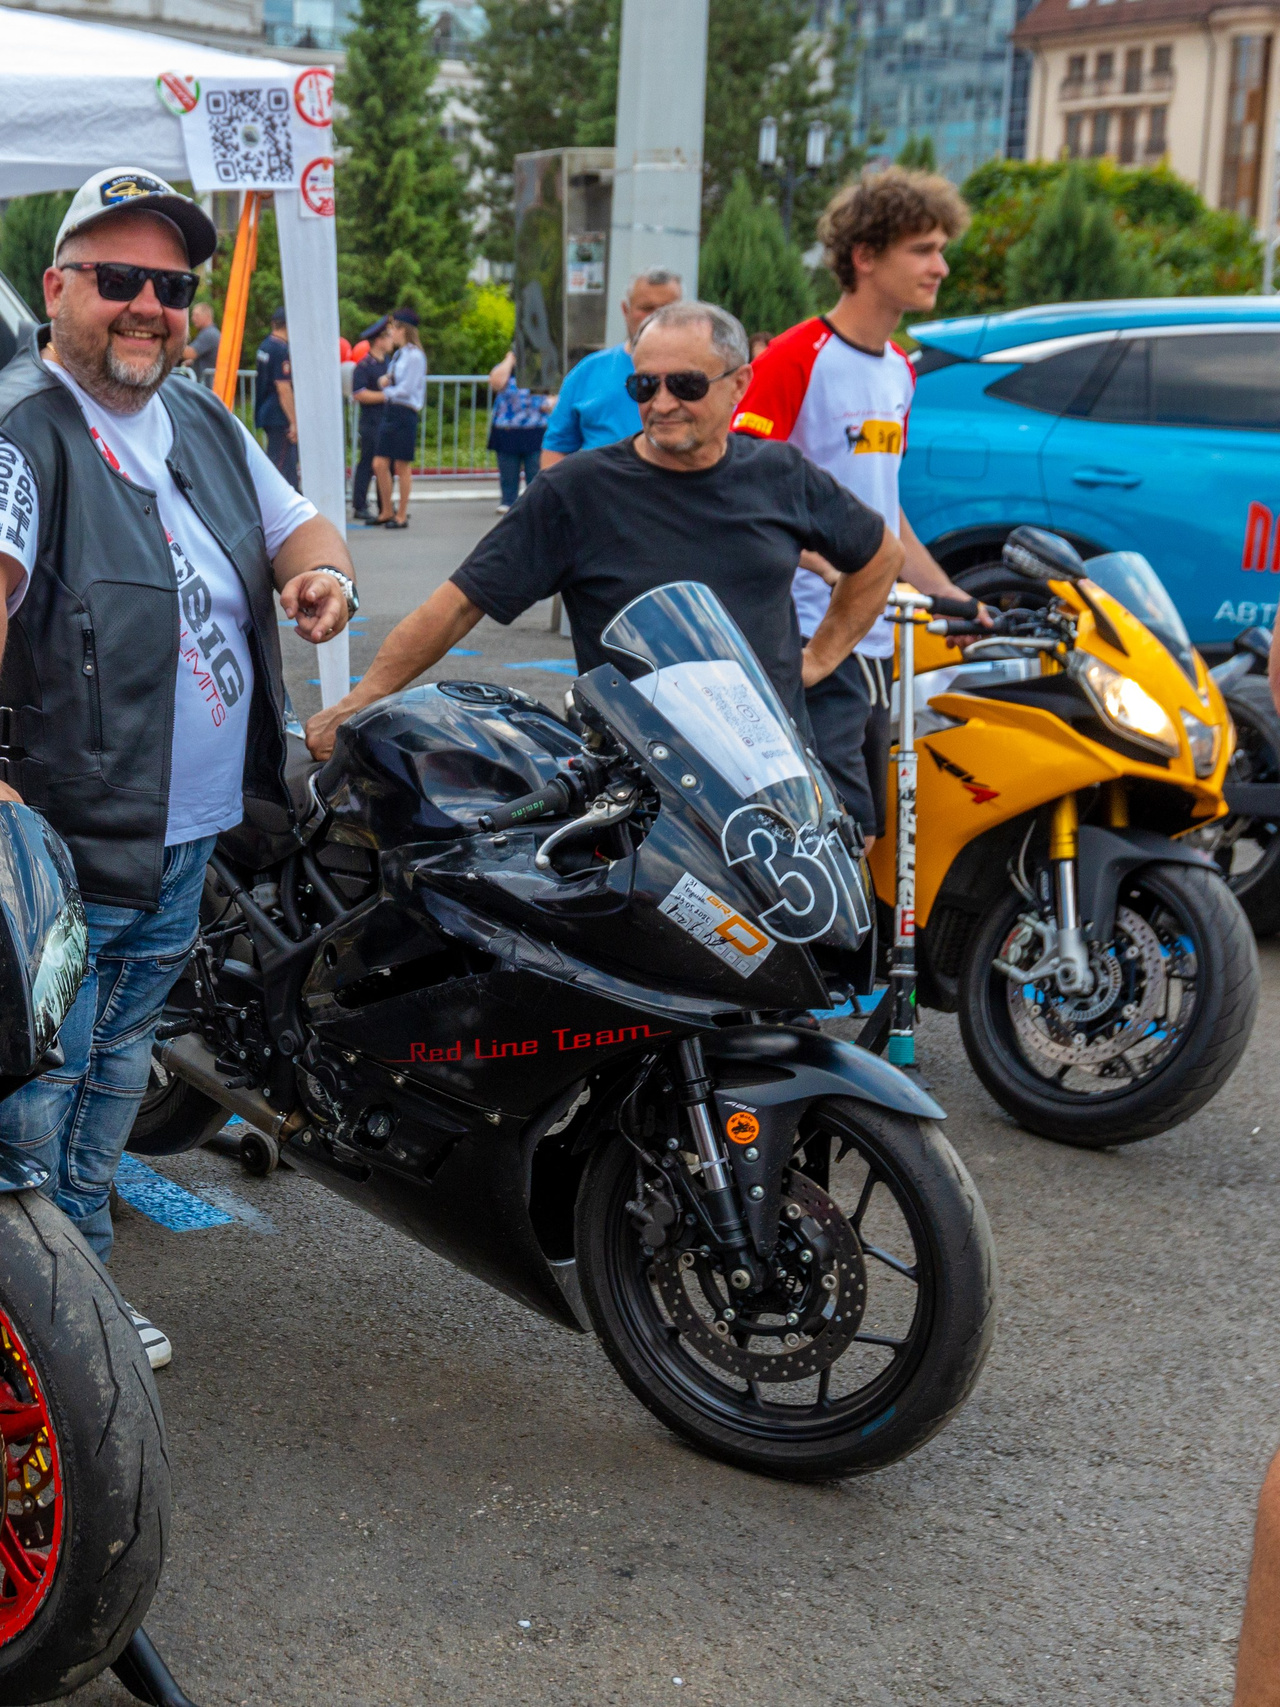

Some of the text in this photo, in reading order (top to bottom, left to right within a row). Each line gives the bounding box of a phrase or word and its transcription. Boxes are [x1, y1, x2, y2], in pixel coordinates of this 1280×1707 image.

[179, 574, 245, 708] BIG
[721, 803, 872, 944] 31
[410, 1024, 651, 1063] Red Line Team
